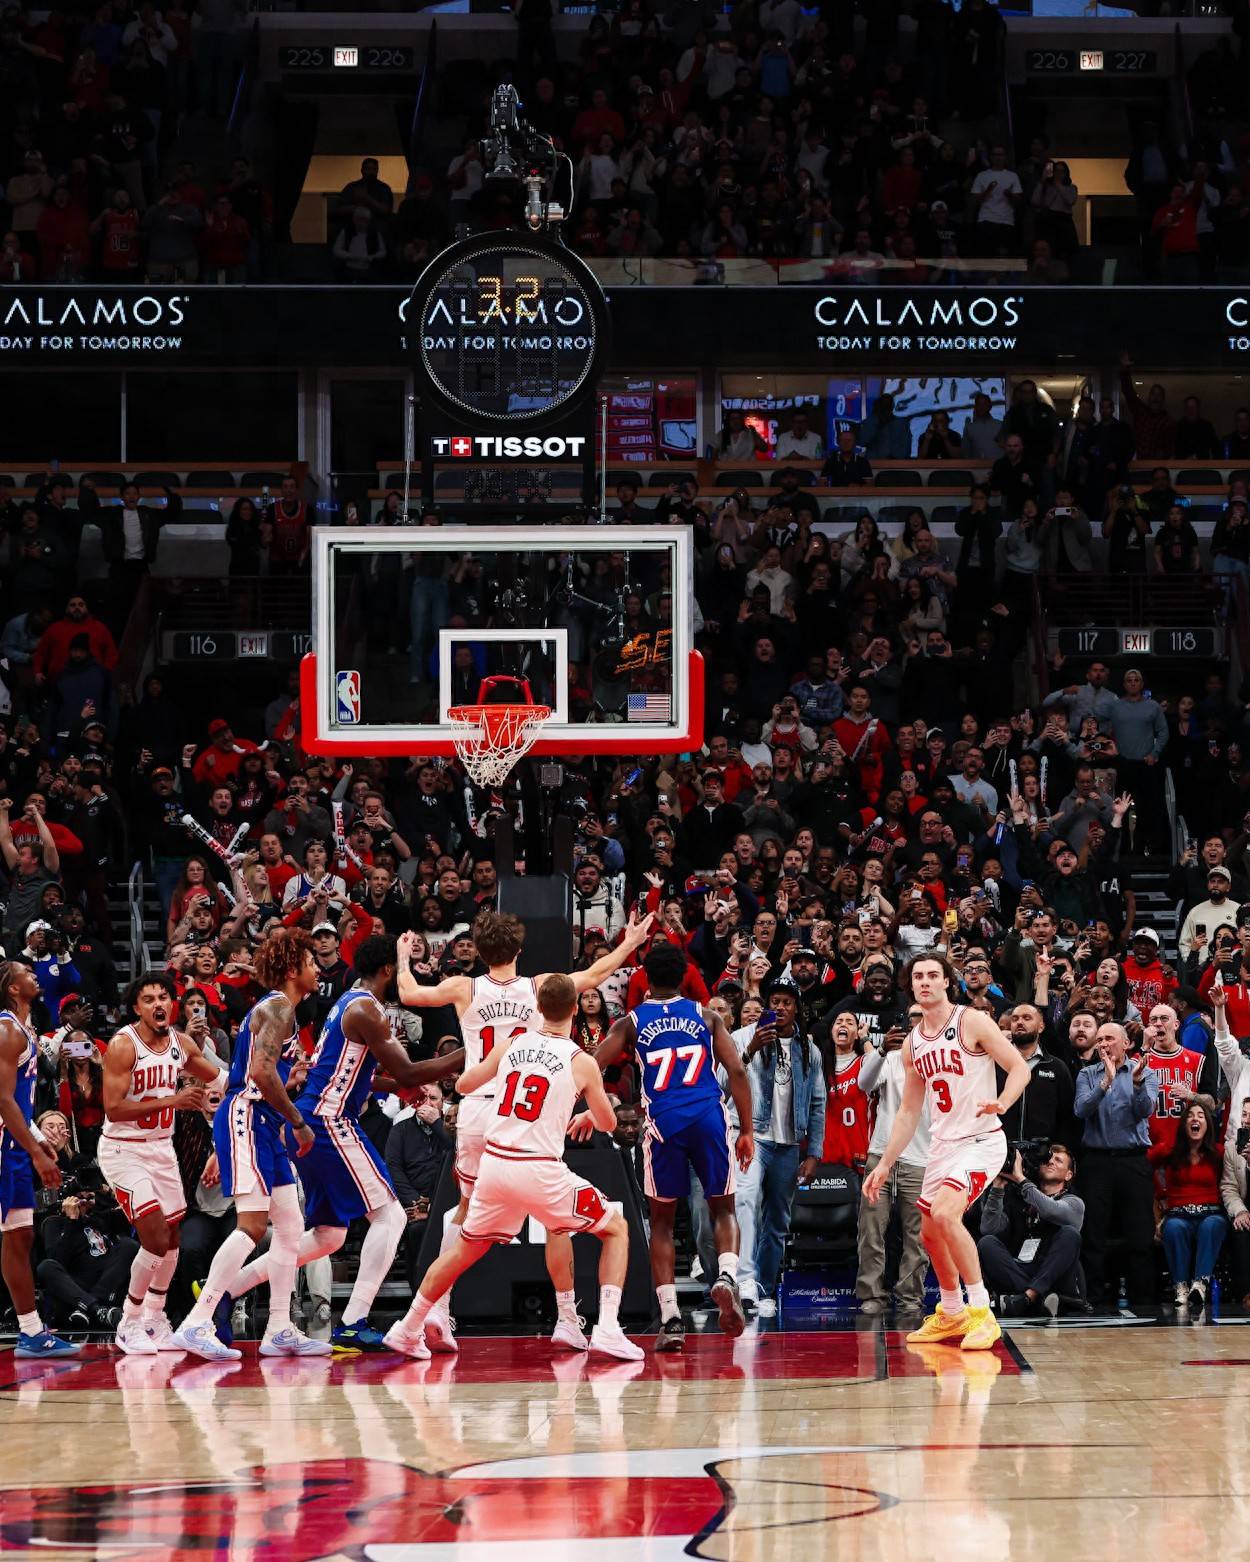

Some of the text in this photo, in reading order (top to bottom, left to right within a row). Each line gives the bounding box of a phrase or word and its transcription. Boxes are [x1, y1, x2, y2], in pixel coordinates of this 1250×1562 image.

[335, 50, 357, 65] EXIT
[1031, 52, 1147, 70] 226 EXIT 227
[476, 277, 540, 317] 3.2
[815, 297, 1019, 327] CALAMOS
[40, 336, 74, 350] FOR
[80, 336, 182, 350] TOMORROW
[463, 336, 496, 350] FOR
[817, 336, 1017, 350] TODAY FOR TOMORROW
[474, 437, 586, 457] TISSOT
[190, 635, 217, 655] 116
[241, 637, 265, 654] EXIT
[1078, 631, 1197, 652] 117 EXIT 118
[477, 1001, 533, 1023] BUZELIS
[637, 1016, 705, 1047] EDGECOMBE
[508, 1049, 565, 1076] HUERTER
[646, 1044, 707, 1092] 77
[1156, 1067, 1193, 1088] ULLS
[497, 1070, 550, 1123] 13
[931, 1079, 953, 1114] 3
[1156, 1089, 1187, 1119] 13
[842, 1107, 856, 1127] 0
[820, 1176, 848, 1186] RABIDA
